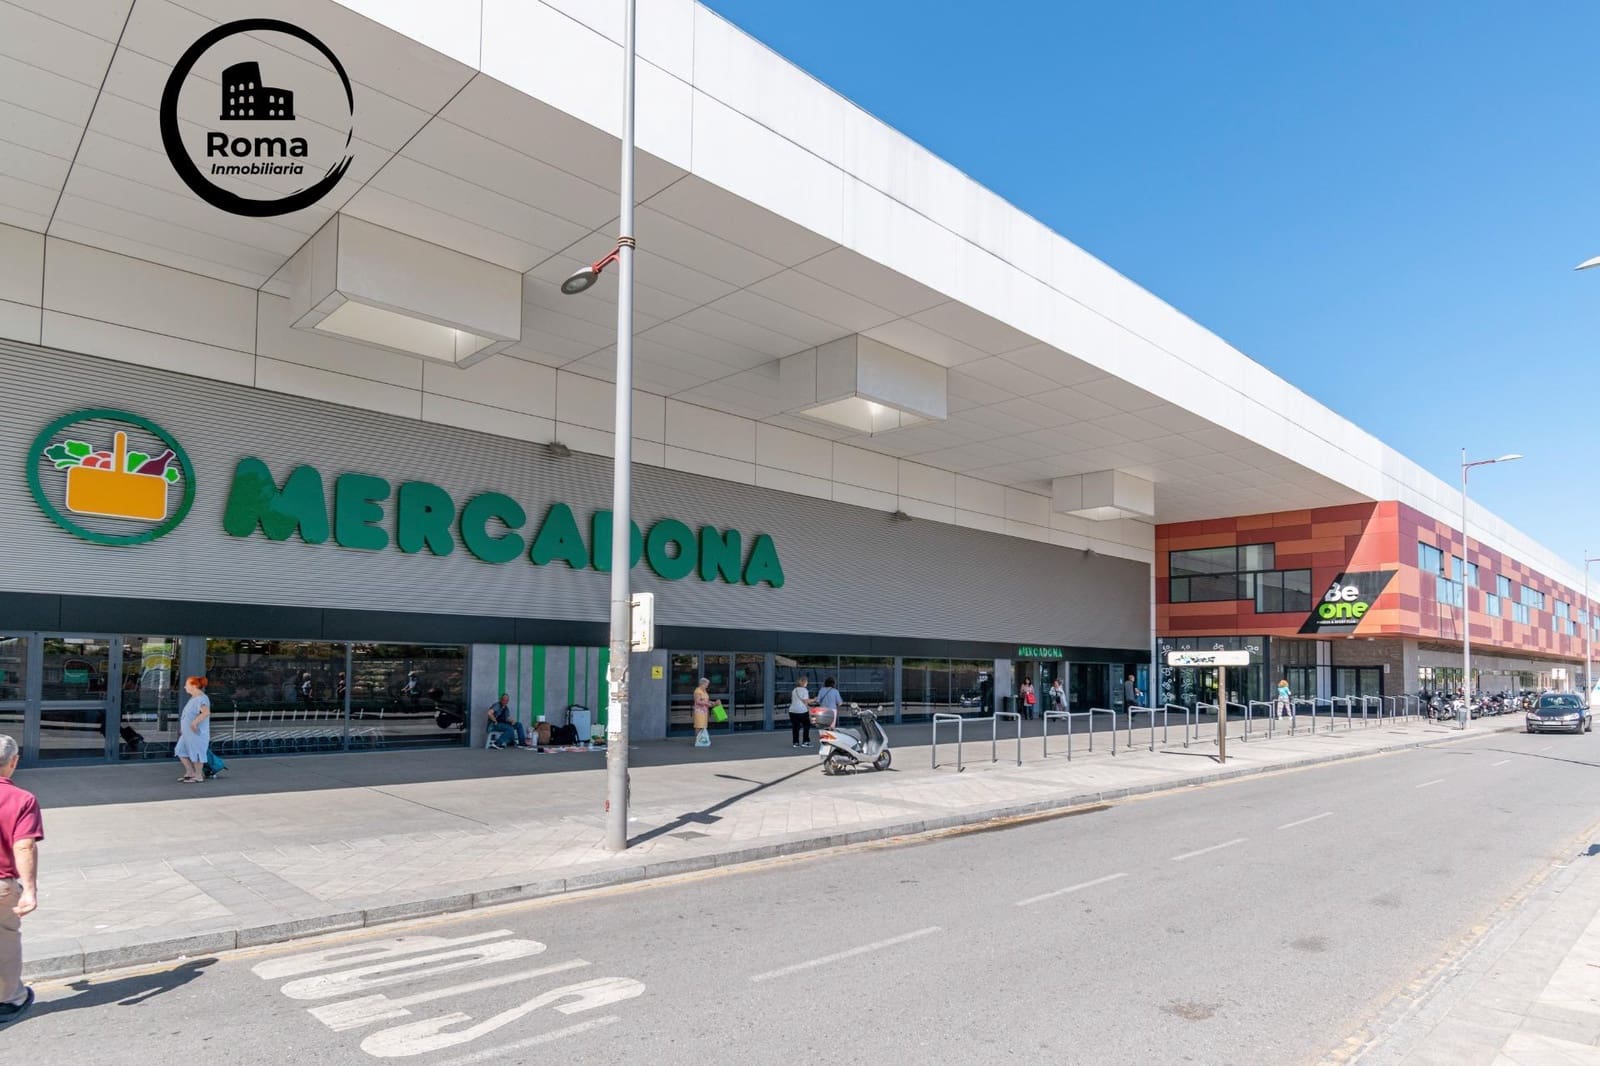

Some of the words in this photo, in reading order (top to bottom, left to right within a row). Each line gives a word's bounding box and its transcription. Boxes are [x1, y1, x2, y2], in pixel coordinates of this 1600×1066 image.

[223, 457, 784, 588] MERCADONA
[1318, 601, 1369, 619] one
[1018, 646, 1063, 657] MERCADONA
[251, 929, 646, 1057] STOP
